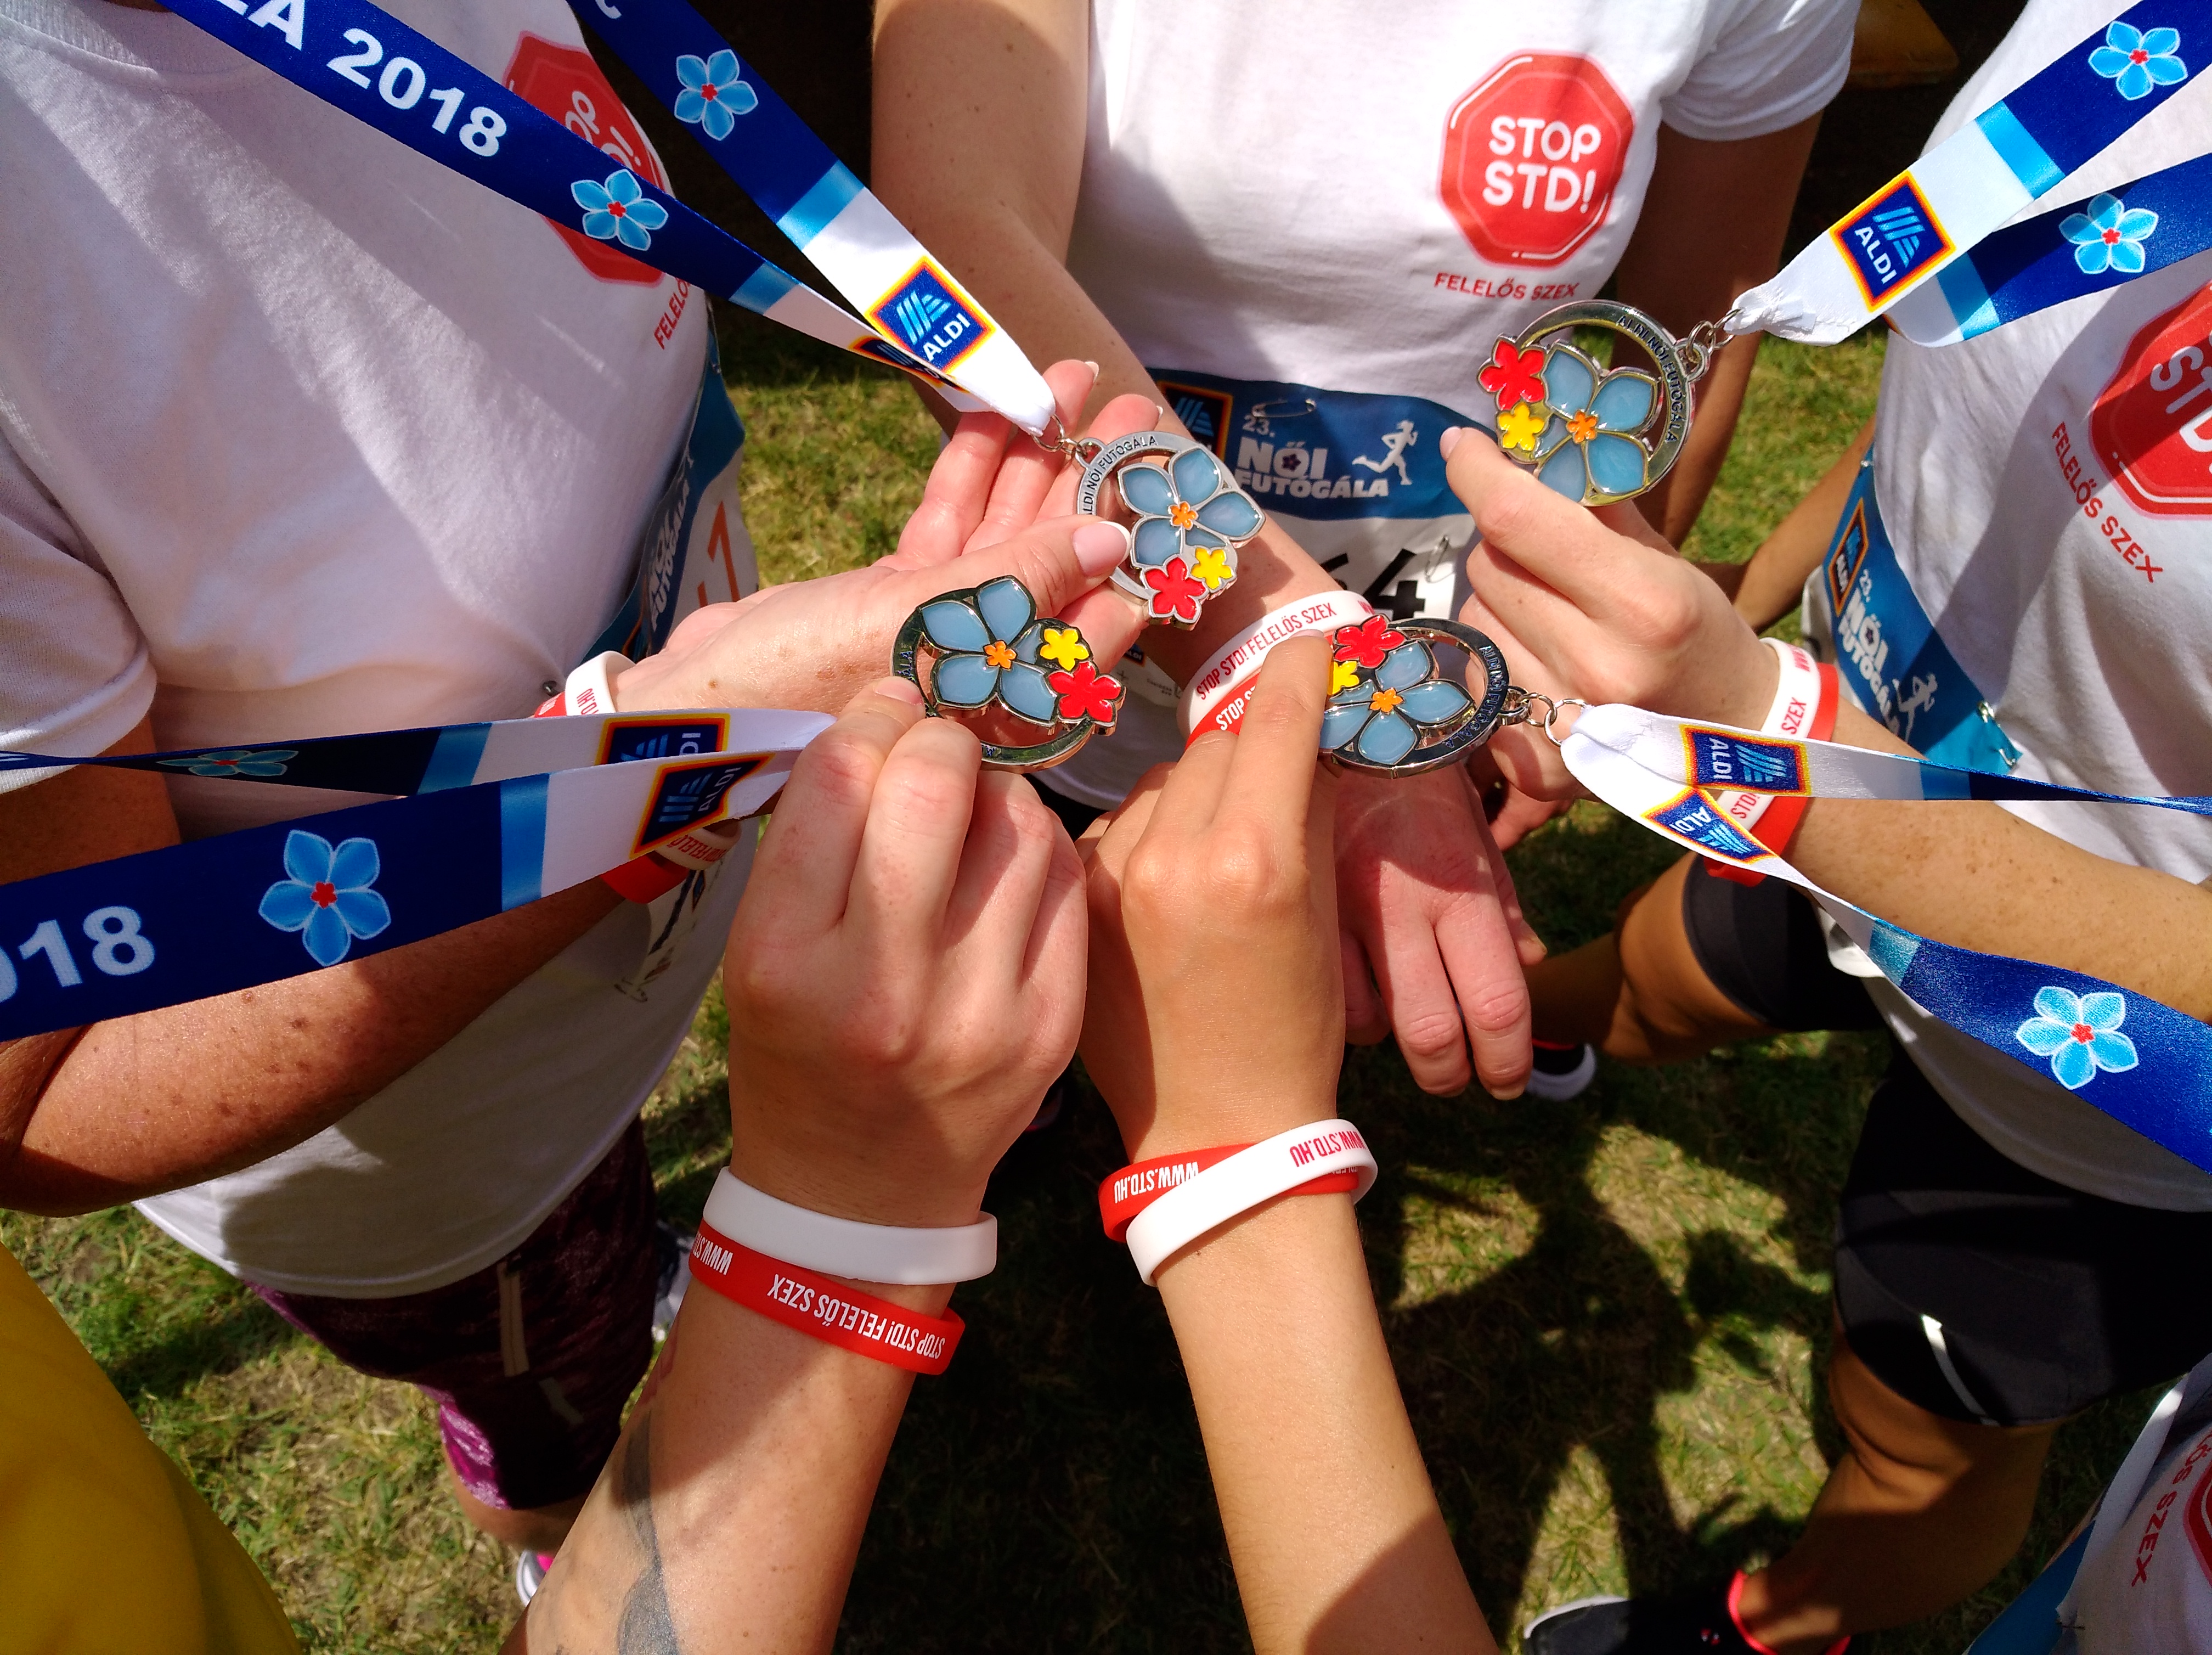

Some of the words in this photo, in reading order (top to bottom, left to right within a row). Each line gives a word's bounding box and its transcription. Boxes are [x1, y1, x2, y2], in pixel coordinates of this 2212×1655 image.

[326, 28, 507, 157] 2018
[1489, 116, 1601, 163] STOP
[1482, 160, 1596, 213] STD!
[1855, 226, 1897, 284] ALDI
[1434, 271, 1526, 301] FELELŐS
[1531, 283, 1581, 301] SZEX
[654, 277, 691, 350] FELELŐ
[923, 312, 971, 362] ALDI
[1243, 414, 1276, 438] 23.
[1237, 436, 1328, 480] NŐI
[2051, 421, 2103, 519] FELELŐS
[2101, 515, 2164, 583] SZEX
[1197, 668, 1221, 700] STOP
[1220, 646, 1249, 676] STD!
[1246, 613, 1303, 656] FELELŐS
[1301, 603, 1338, 624] SZEX
[1215, 697, 1245, 731] STOP
[1781, 697, 1807, 735] SZEX
[1708, 737, 1733, 780] ALDI
[697, 767, 742, 812] ALDI
[1669, 806, 1712, 834] ALDI
[766, 1274, 816, 1313] SZEX
[814, 1294, 888, 1341] FELELŐS
[884, 1320, 919, 1352] STD!
[916, 1332, 946, 1360] STOP
[2131, 1491, 2178, 1588] SZEX
